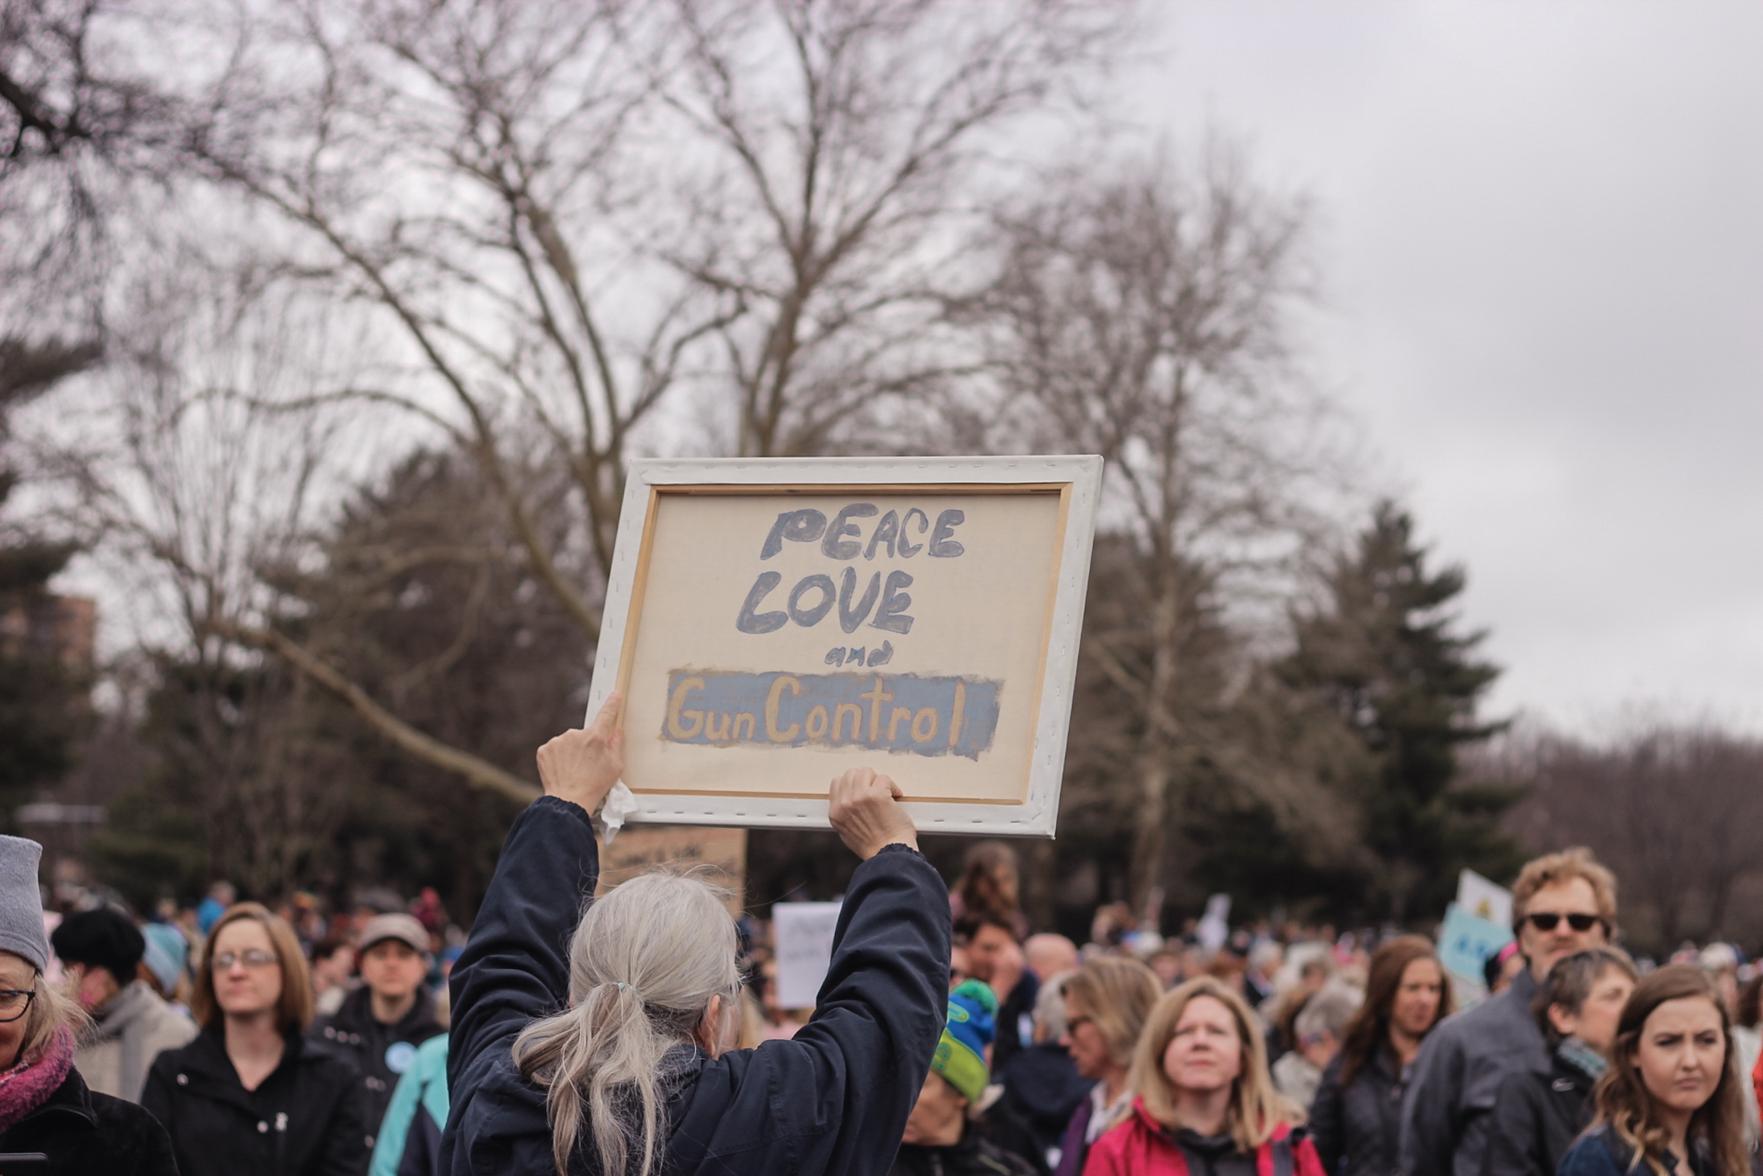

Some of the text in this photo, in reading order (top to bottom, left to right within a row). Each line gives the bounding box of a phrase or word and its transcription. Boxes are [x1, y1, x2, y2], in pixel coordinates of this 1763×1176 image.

[760, 503, 965, 560] PEACE
[736, 566, 915, 634] LOVE
[824, 640, 894, 667] and
[668, 675, 966, 746] Gun Control
